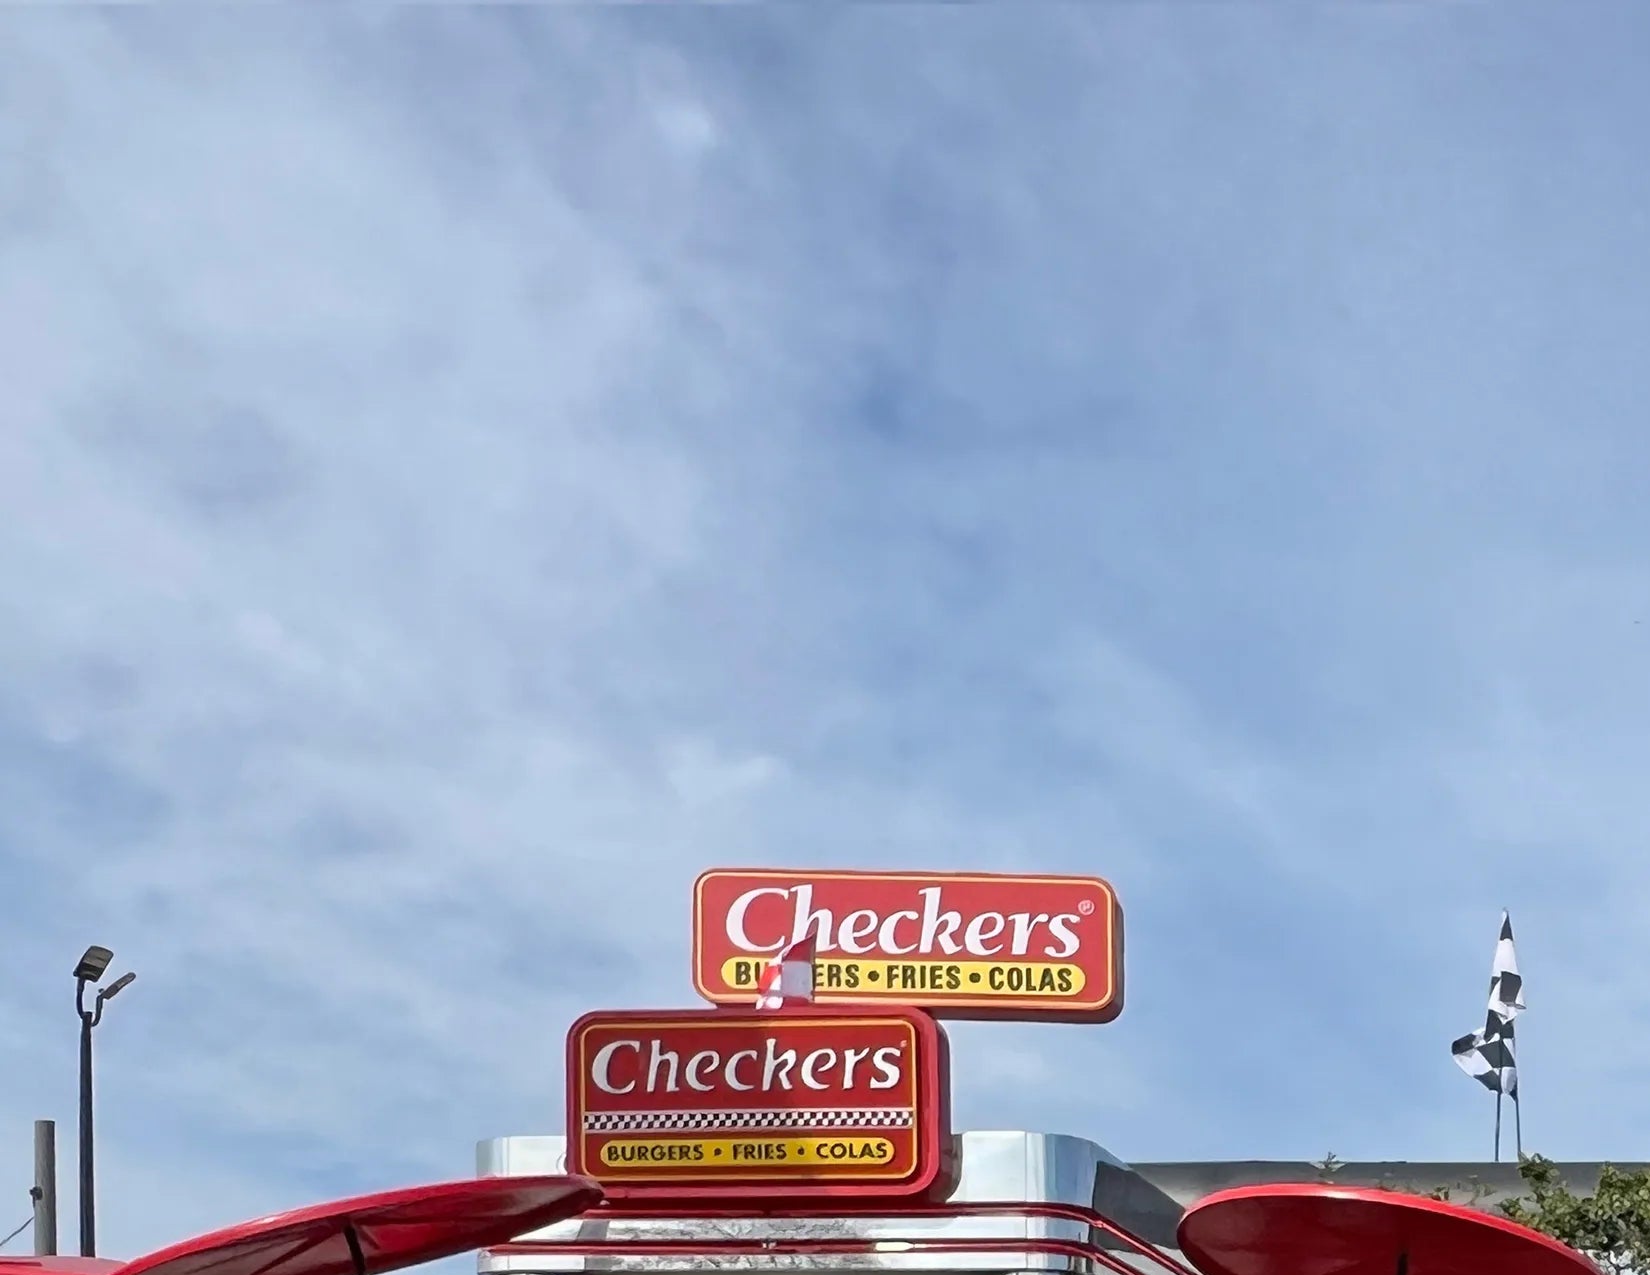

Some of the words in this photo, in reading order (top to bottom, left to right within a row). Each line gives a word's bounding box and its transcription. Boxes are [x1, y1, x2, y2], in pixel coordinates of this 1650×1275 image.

[725, 884, 1081, 958] Checkers
[735, 961, 860, 988] BERS
[886, 964, 961, 991] FRIES
[989, 966, 1073, 993] COLAS
[591, 1038, 901, 1095] Checkers
[606, 1143, 704, 1162] BURGERS
[732, 1142, 788, 1161] FRIES
[815, 1141, 888, 1160] COLAS
